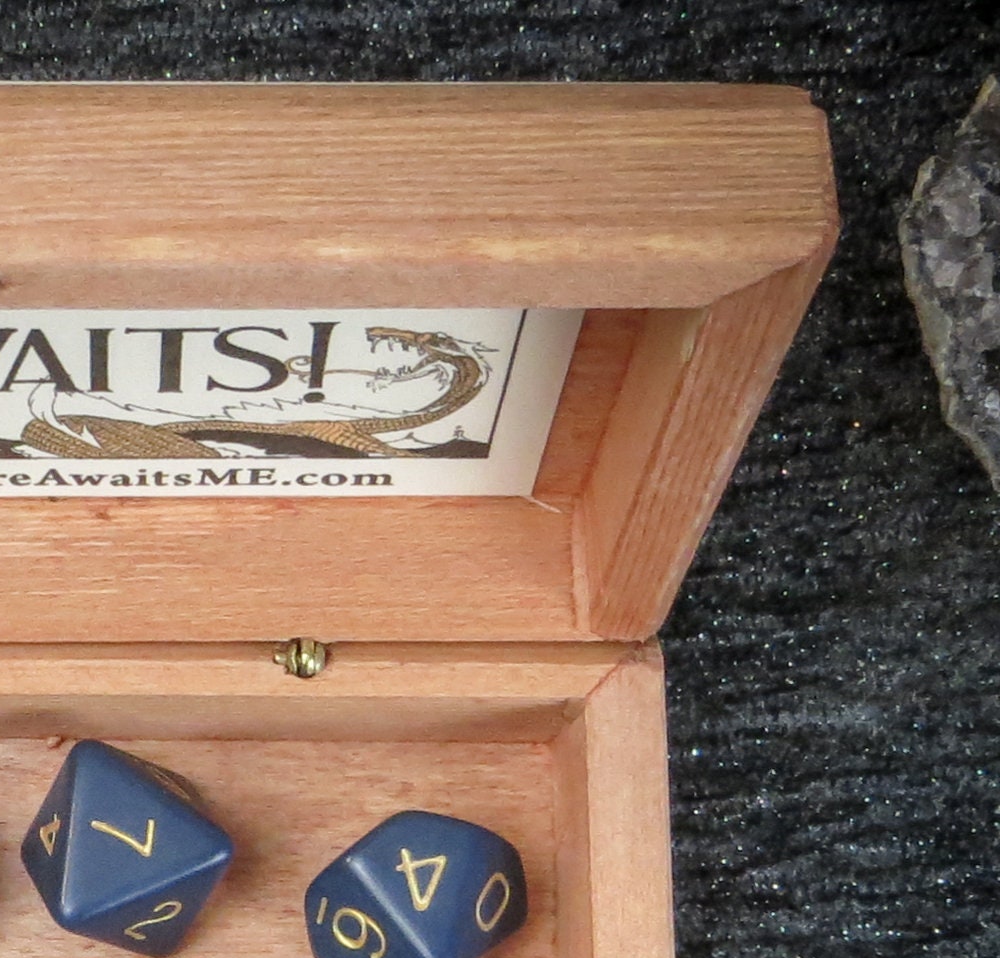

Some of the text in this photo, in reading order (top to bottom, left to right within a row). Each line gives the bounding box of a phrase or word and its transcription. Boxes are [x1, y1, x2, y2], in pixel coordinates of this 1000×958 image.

[395, 847, 448, 912] 4
[475, 872, 511, 932] 0
[123, 900, 183, 941] 2
